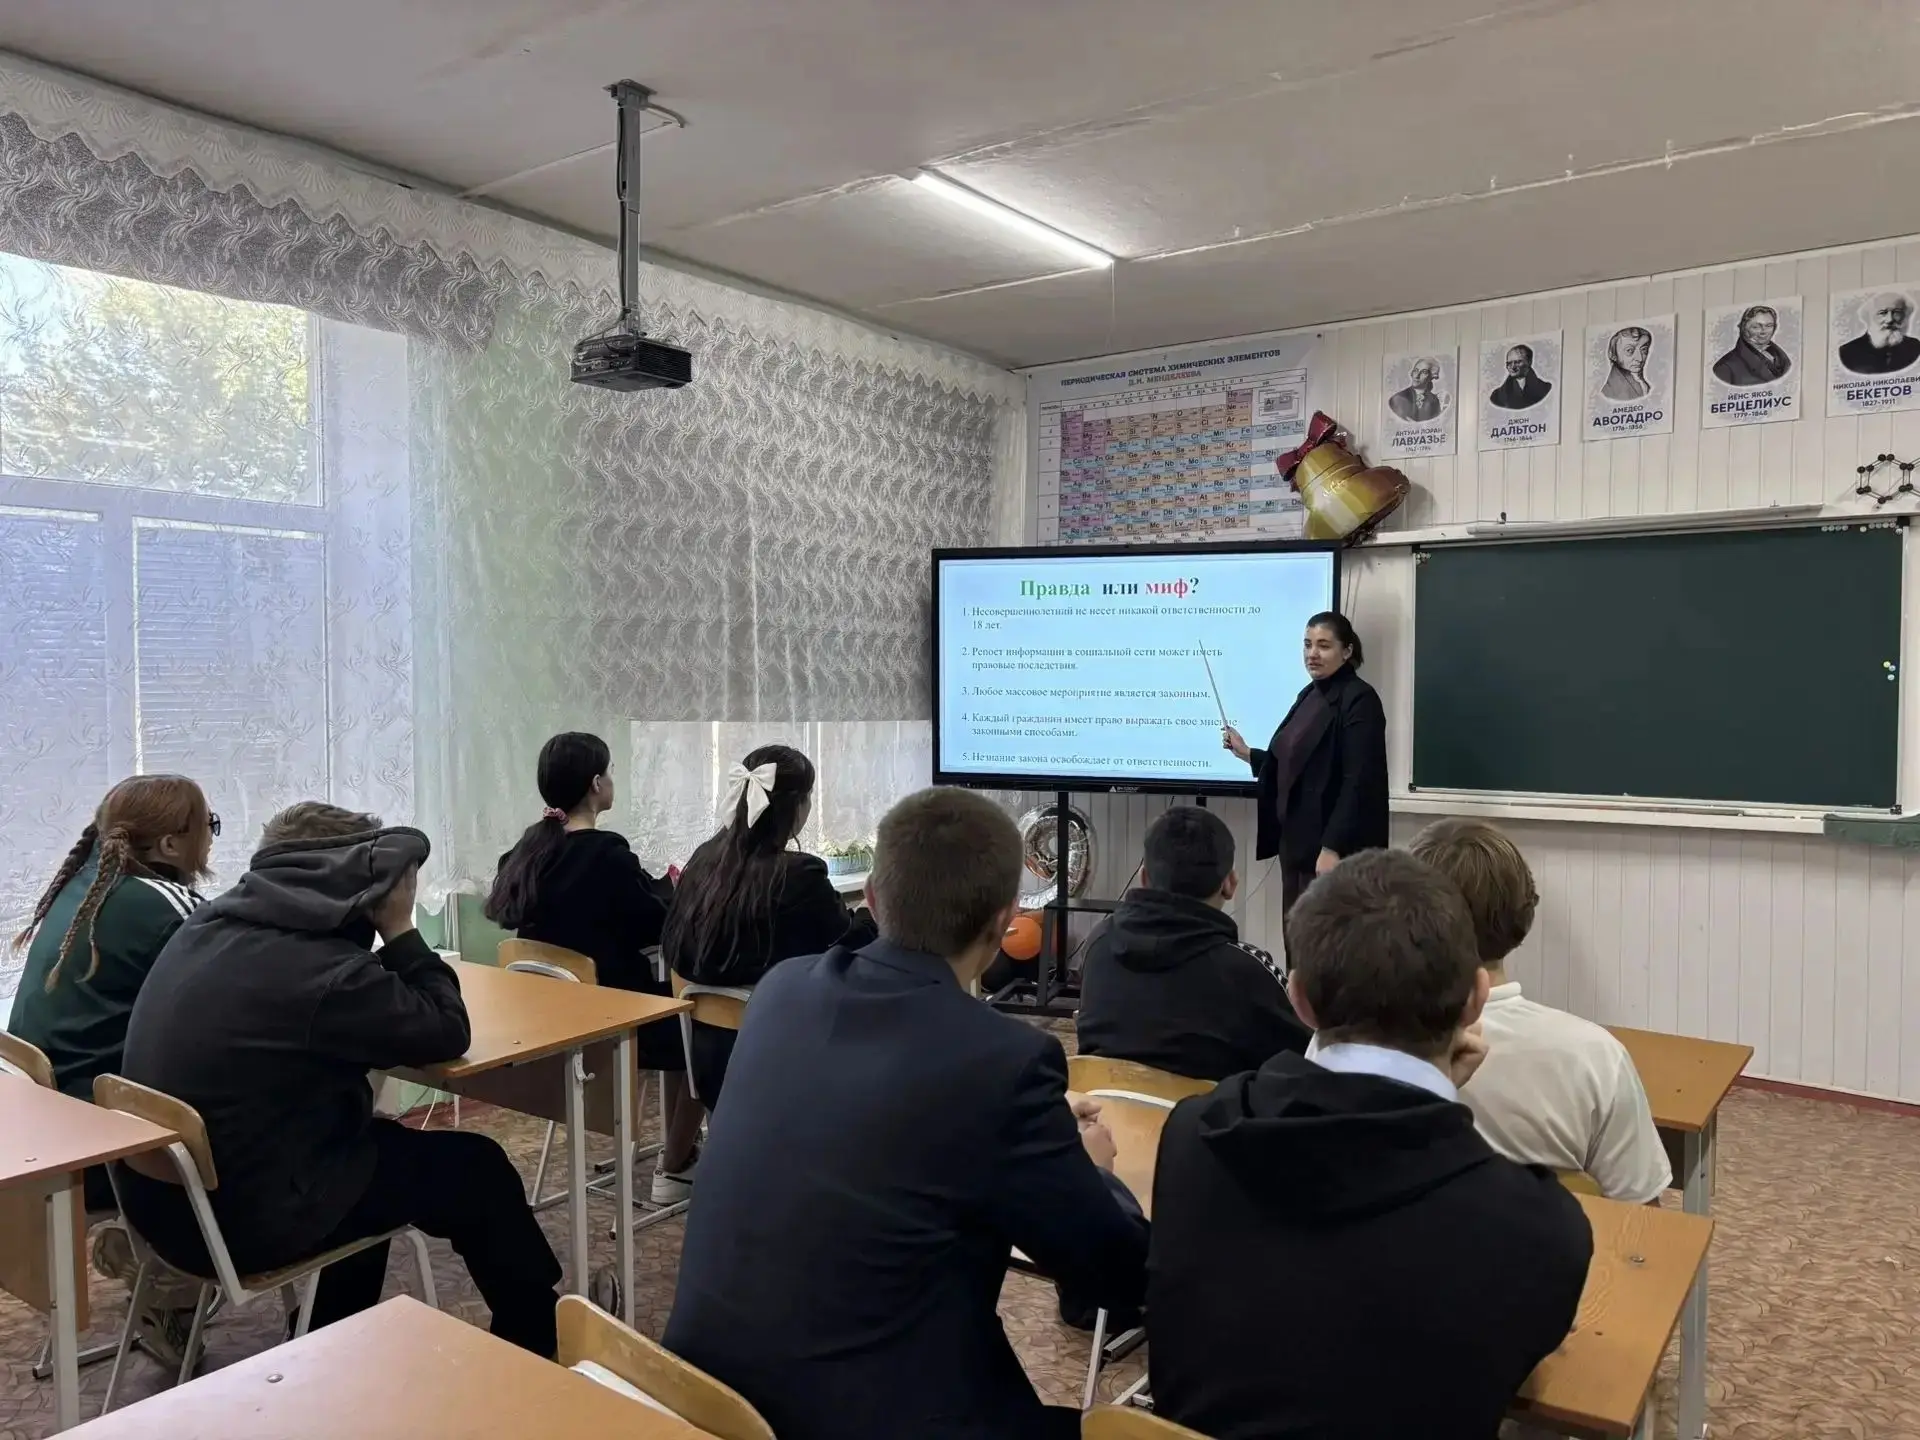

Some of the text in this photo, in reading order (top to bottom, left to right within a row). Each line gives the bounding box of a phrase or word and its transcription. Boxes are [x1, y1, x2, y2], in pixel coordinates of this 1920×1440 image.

[1061, 349, 1281, 386] ПЕРИОДИЧЕСКАЯ СИСТЕМА ХИМИЧЕСКИХ ЭЛЕМЕНТОВ
[1833, 381, 1871, 390] НИКОЛАЙ
[1752, 390, 1773, 398] ЯКОБ
[1847, 386, 1912, 400] БЕКЕТОВ
[1612, 405, 1643, 414] АМЕДЕО
[1711, 396, 1792, 413] БЕРЦЕЛИУС
[1508, 417, 1529, 425] ДЖОН
[1593, 411, 1663, 426] АВОГАДРО
[1491, 423, 1546, 438] ДАЛЬТОН
[1392, 434, 1446, 447] ЛАВУАЗЬЕ
[1021, 577, 1200, 600] Правда или миф?
[972, 606, 1073, 618] Несовершеннолетний
[1076, 607, 1087, 616] не
[1089, 607, 1115, 616] несет
[1119, 606, 1159, 615] никакой
[1161, 606, 1245, 615] ответственности
[1248, 606, 1261, 616] до
[973, 620, 1002, 630] 18 лет.
[962, 647, 970, 656] 2.
[1006, 647, 1065, 658] информации
[1075, 647, 1131, 657] социальной
[1134, 648, 1156, 656] сети
[972, 661, 1016, 671] правовые
[962, 687, 1211, 699] 3. Любое массовое мероприятие является законным.
[962, 713, 969, 722] 4.
[972, 713, 1009, 723] Каждый
[1012, 715, 1062, 725] гражданин
[1065, 716, 1092, 724] имеет
[1095, 717, 1123, 726] право
[1125, 717, 1172, 726] выражать
[1175, 718, 1197, 726] свое
[972, 728, 1078, 737] законными способами.
[963, 752, 970, 761] 5.
[972, 752, 1016, 762] Незнание
[1018, 755, 1048, 763] закона
[1050, 755, 1110, 765] освобождает
[1126, 758, 1212, 767] ответственности.
